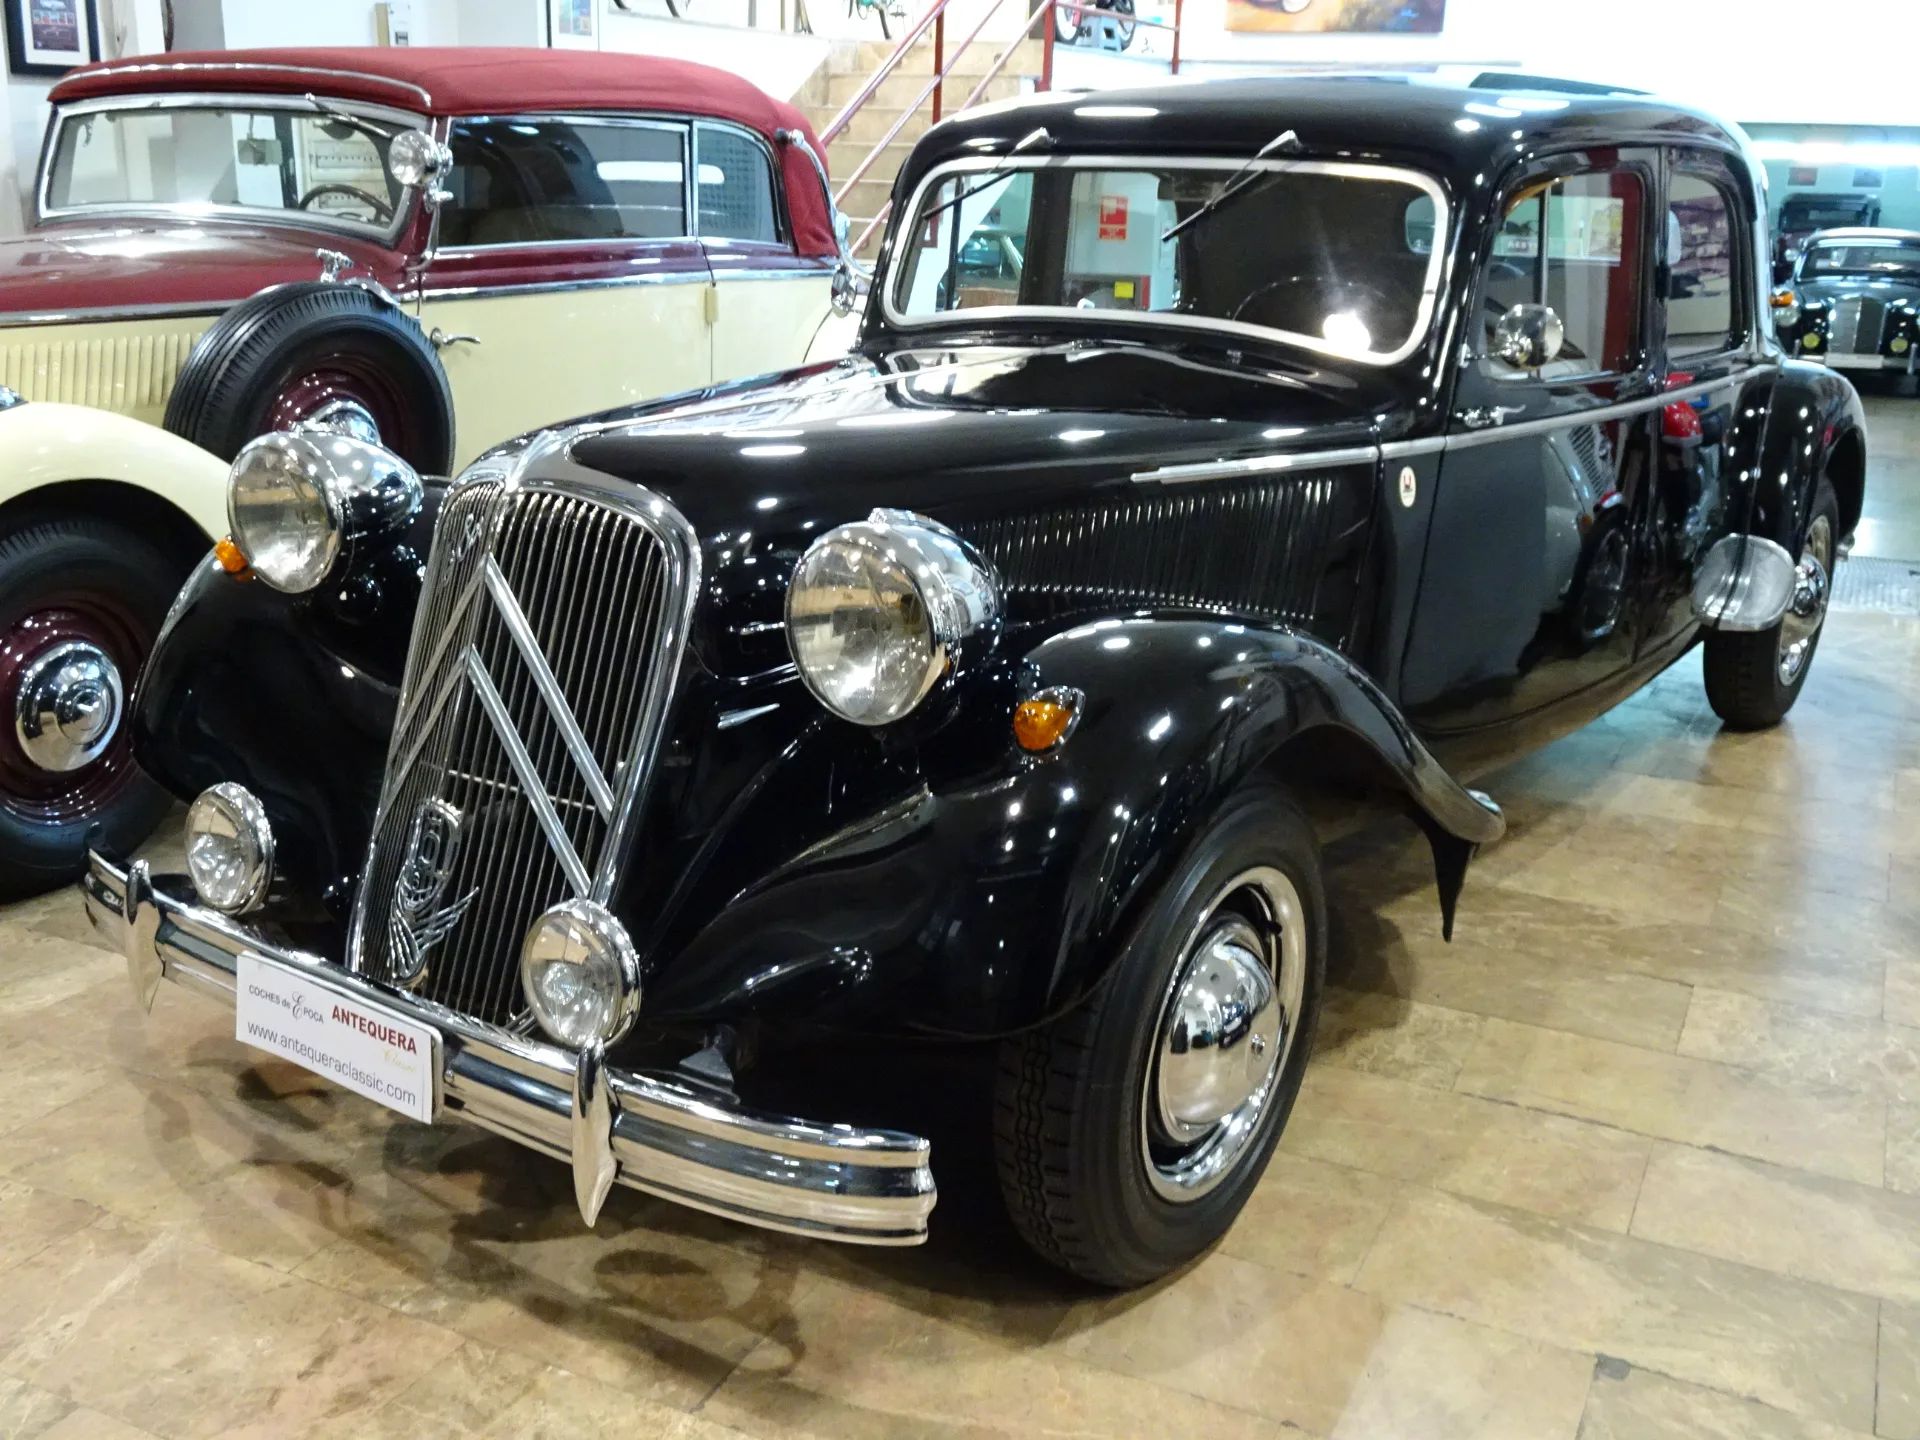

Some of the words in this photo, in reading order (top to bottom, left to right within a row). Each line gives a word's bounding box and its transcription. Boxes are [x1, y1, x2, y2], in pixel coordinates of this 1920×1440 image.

[248, 984, 281, 1005] COCHES
[331, 1005, 418, 1055] ANTEQUERA
[247, 1021, 416, 1106] www.antequeraclassic.com
